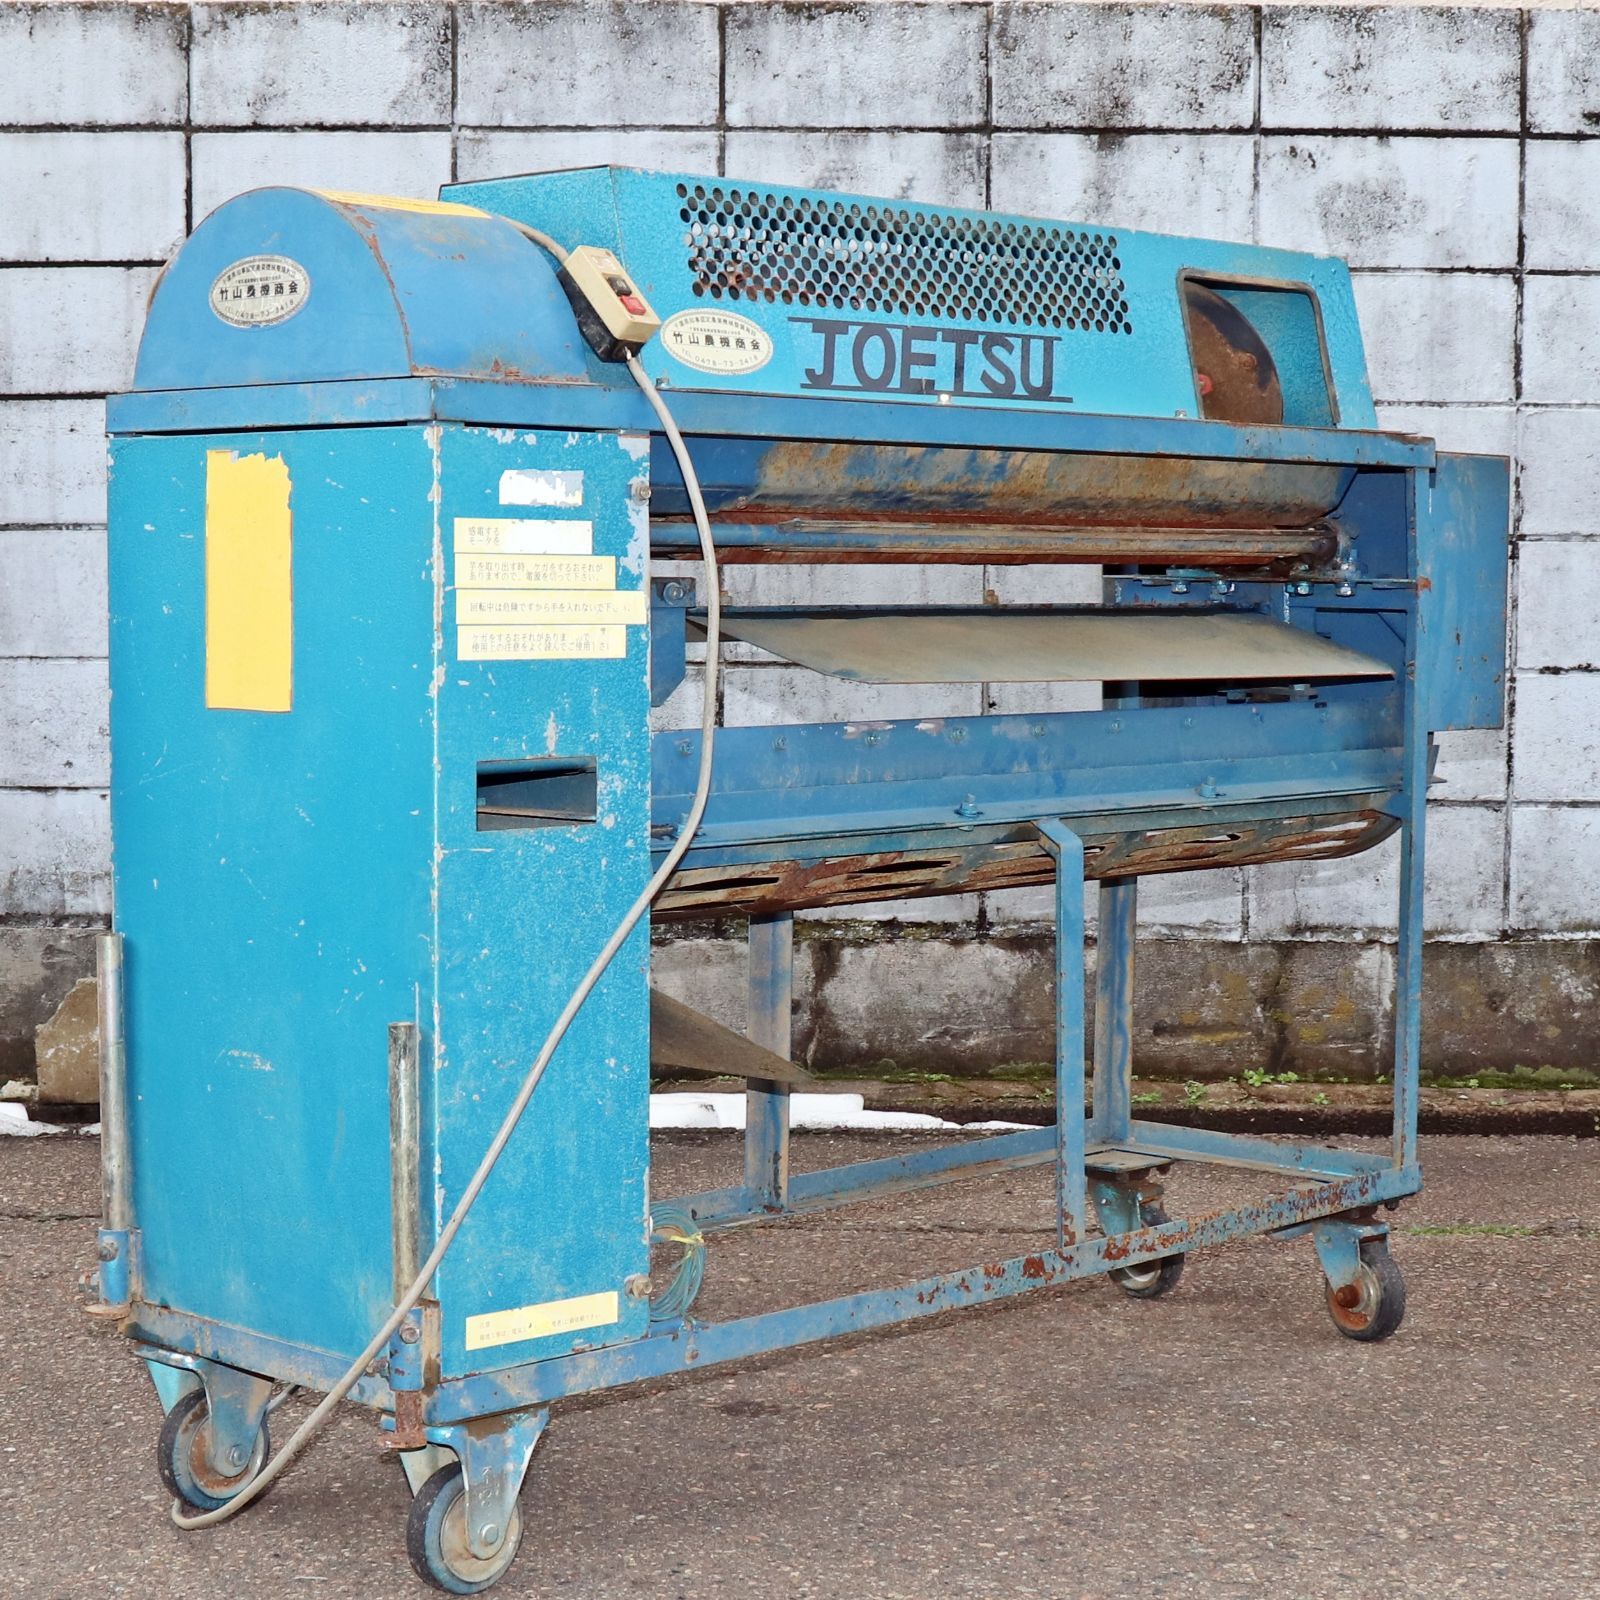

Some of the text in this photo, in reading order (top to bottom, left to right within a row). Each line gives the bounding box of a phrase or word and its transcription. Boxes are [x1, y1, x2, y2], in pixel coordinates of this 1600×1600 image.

[219, 281, 298, 302] 竹山農機商会
[673, 331, 761, 351] 竹山農機商会
[804, 319, 1055, 398] JOETSU
[470, 601, 632, 613] 回転中は危険ですから手を入れないで下。
[472, 632, 592, 642] ケガをするおそれがありまで
